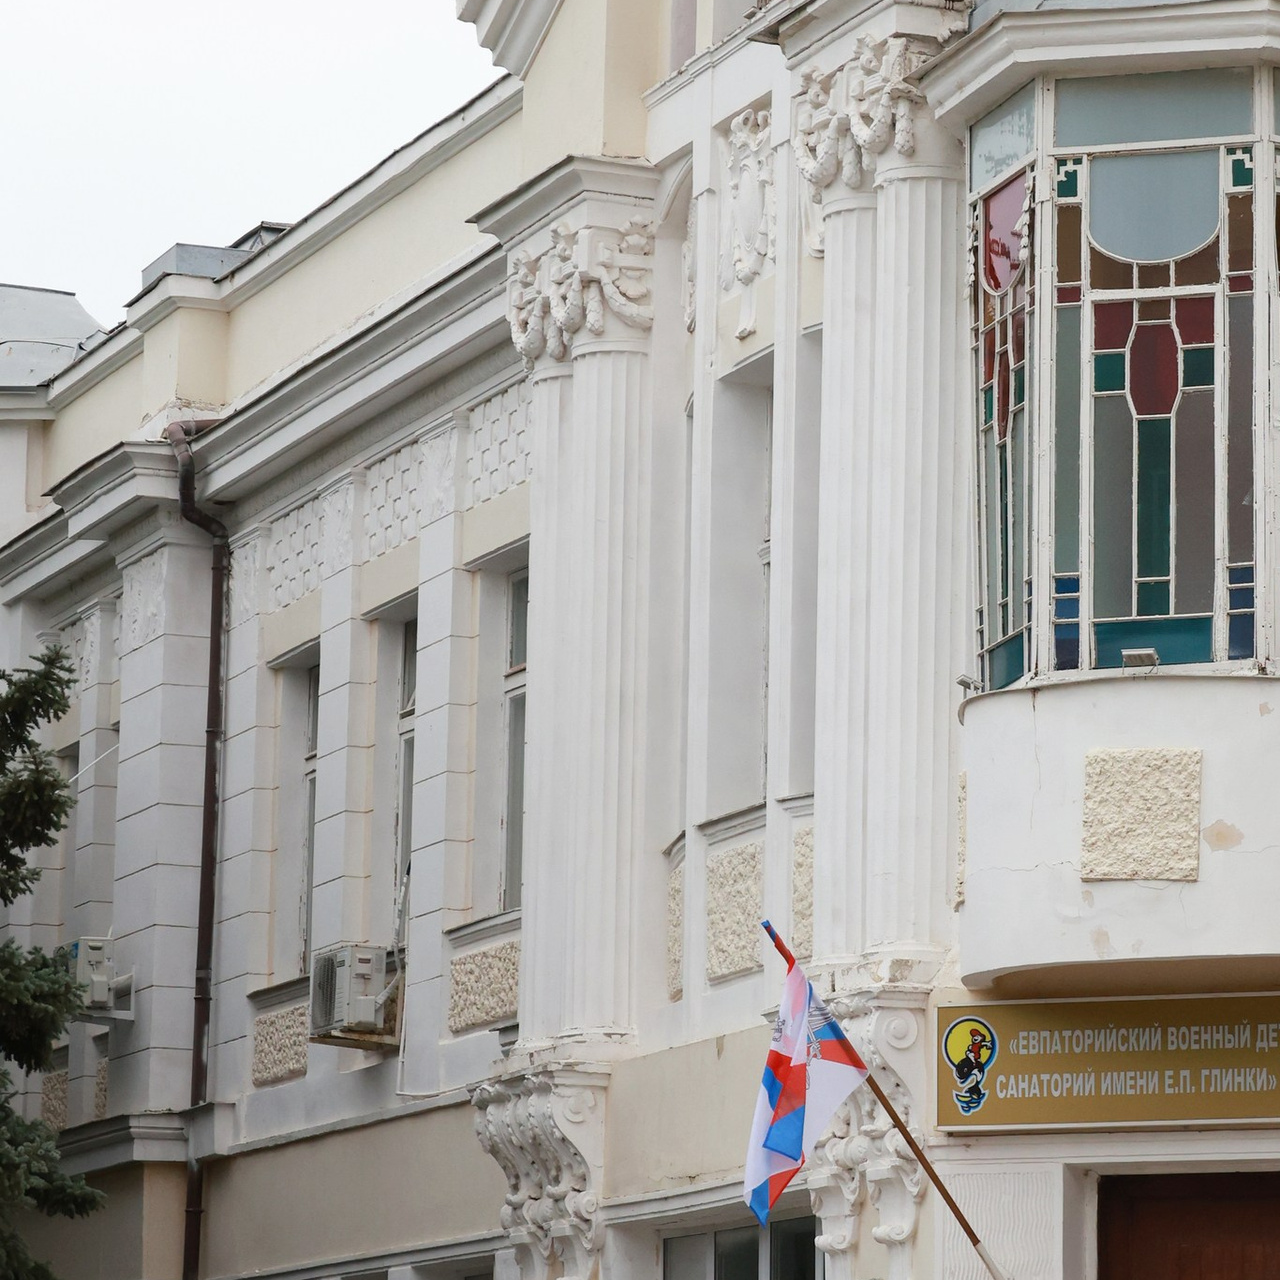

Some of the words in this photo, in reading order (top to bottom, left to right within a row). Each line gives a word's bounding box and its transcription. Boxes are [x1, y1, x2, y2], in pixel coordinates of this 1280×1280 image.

[1009, 1021, 1162, 1055] «ЕВПАТОРИЙСКИЙ
[1167, 1019, 1251, 1051] ВОЕННЫЙ
[996, 1066, 1095, 1099] САНАТОРИЙ
[1101, 1070, 1159, 1096] ИМЕНИ
[1164, 1069, 1195, 1094] Е.П.
[1201, 1066, 1277, 1093] ГЛИНКИ»
